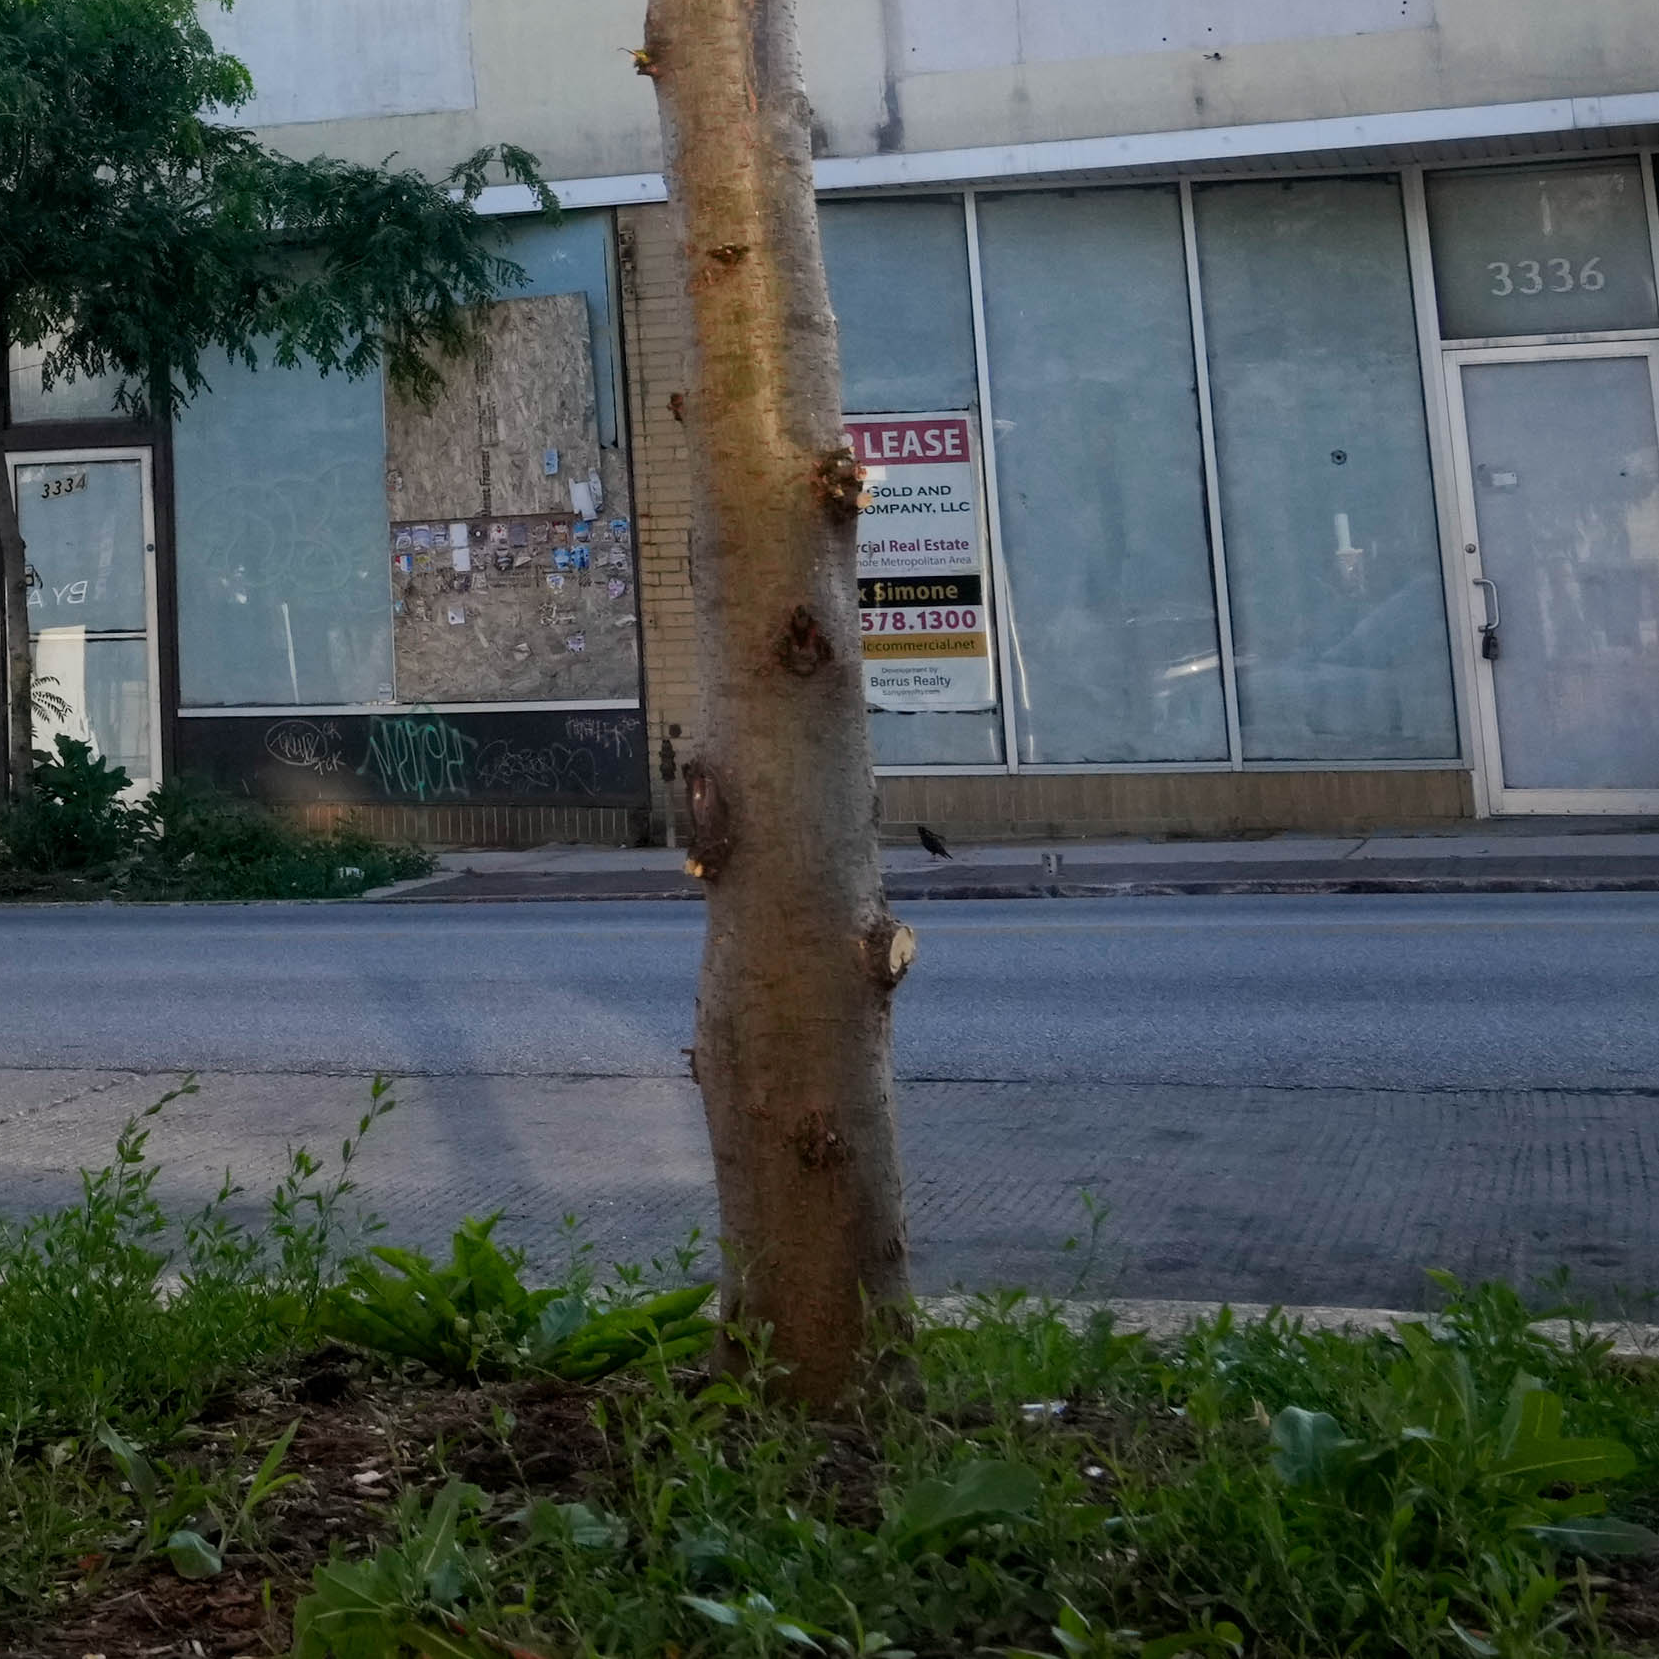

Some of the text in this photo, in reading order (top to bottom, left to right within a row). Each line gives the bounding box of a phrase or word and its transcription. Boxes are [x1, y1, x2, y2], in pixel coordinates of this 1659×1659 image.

[1486, 256, 1606, 297] 3336
[863, 428, 963, 459] LEASE
[867, 485, 952, 499] GOLD AND
[941, 501, 971, 513] LLC
[889, 539, 921, 552] Real
[924, 538, 970, 552] Estate
[881, 556, 947, 569] Metropolitan
[948, 555, 972, 566] Area
[873, 581, 959, 601] Simone
[861, 609, 977, 632] 578.1300
[870, 675, 951, 688] Barrus Realty
